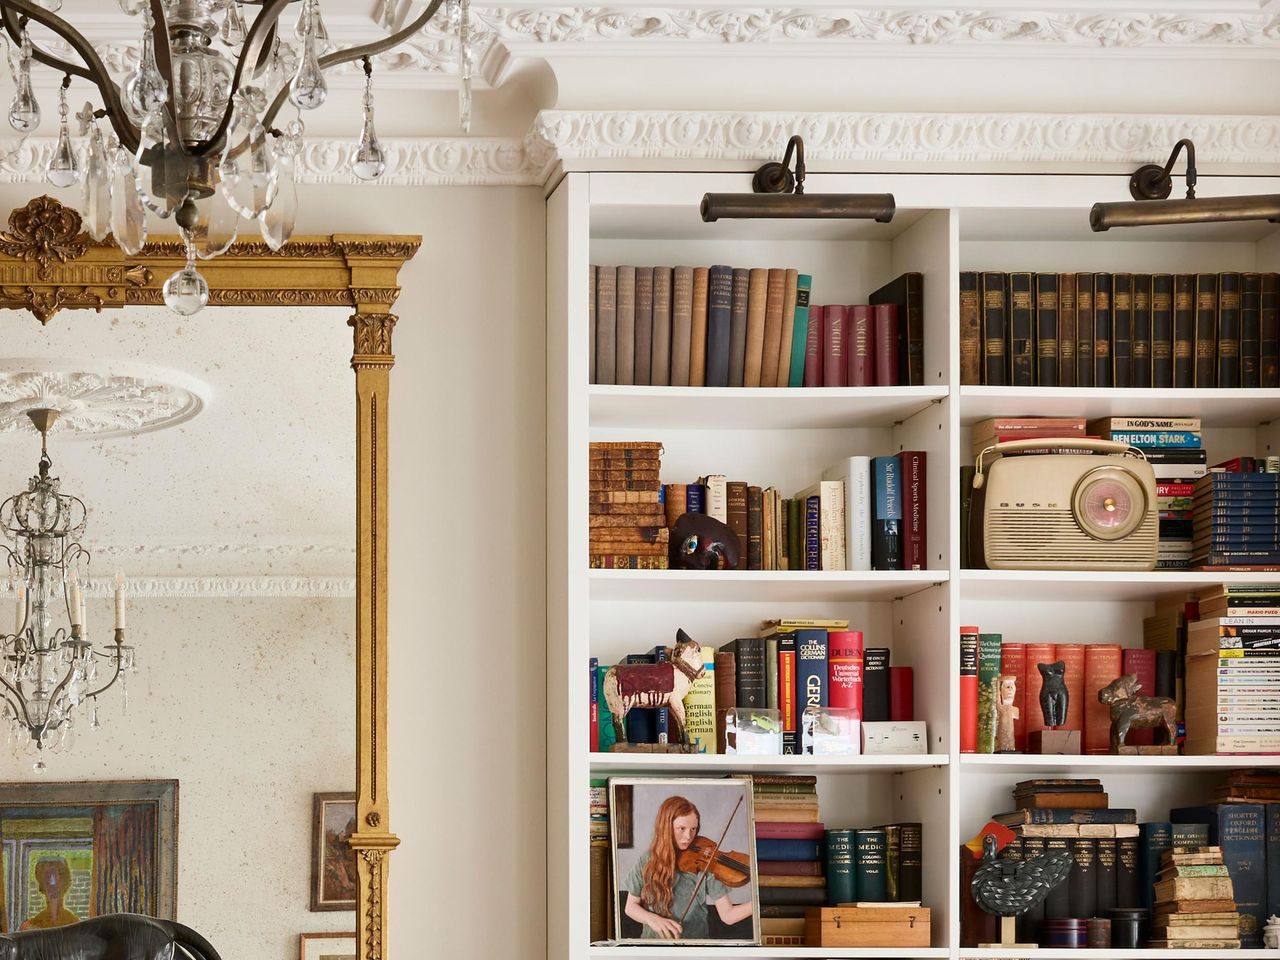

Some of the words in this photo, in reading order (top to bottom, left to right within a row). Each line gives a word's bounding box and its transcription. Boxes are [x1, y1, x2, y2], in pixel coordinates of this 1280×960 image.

[1112, 434, 1130, 444] BEN
[1131, 435, 1156, 444] ELTON
[1159, 435, 1186, 444] STARK
[912, 456, 920, 481] Clinical
[911, 481, 920, 502] Sports
[912, 503, 920, 532] Medicine
[831, 648, 862, 656] DUDEN
[832, 675, 862, 683] Wörterbuch
[684, 710, 712, 718] English
[684, 719, 713, 727] English
